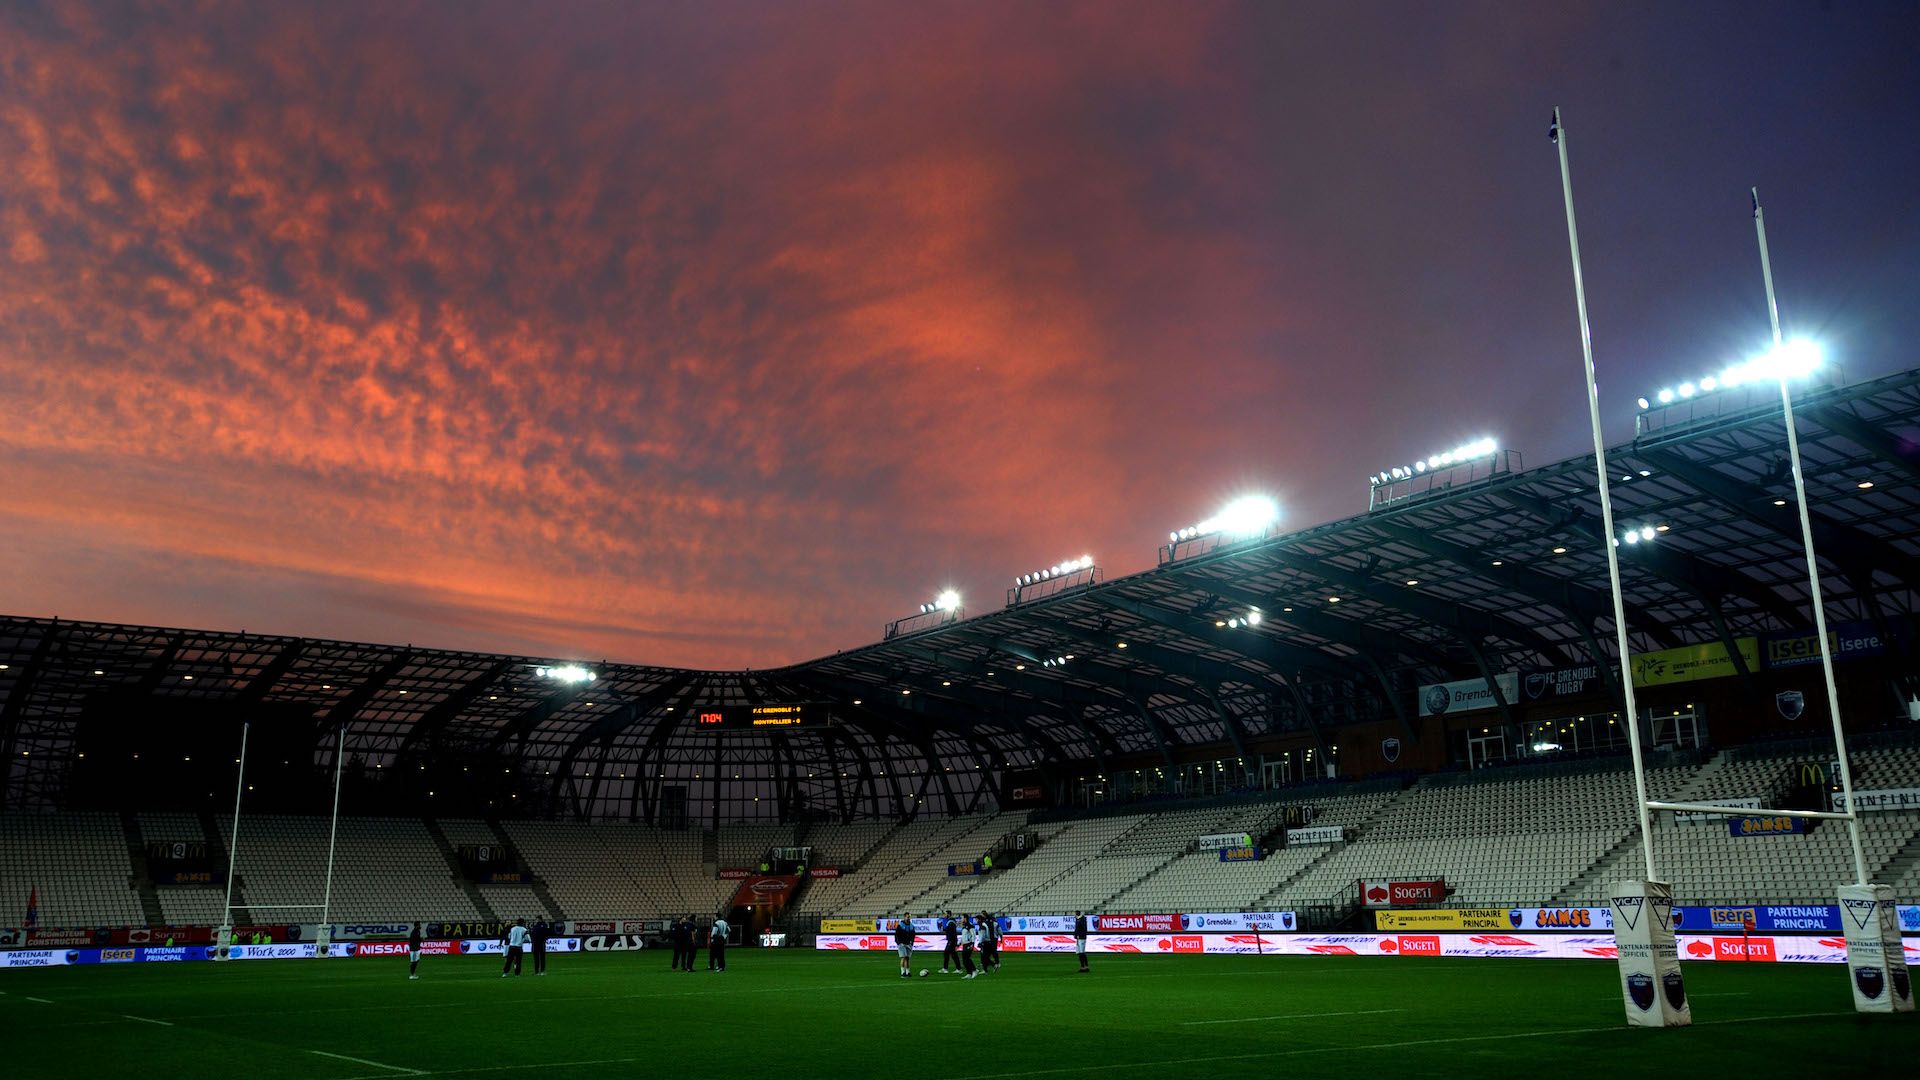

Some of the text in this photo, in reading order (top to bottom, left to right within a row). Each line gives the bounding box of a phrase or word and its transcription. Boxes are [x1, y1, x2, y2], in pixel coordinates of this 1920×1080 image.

[1546, 666, 1597, 685] FC GRENOBLE
[1556, 680, 1584, 695] RUGBY
[763, 706, 792, 714] GRENOBLE
[810, 869, 839, 877] NISSAN
[1394, 886, 1432, 899] SOGETI
[1614, 897, 1643, 906] VICAT
[1844, 900, 1876, 909] VICAT
[1243, 913, 1275, 921] PARTENAIRE
[1459, 910, 1502, 918] PARTENAIRE
[1767, 907, 1829, 918] PARTENAIRE
[1101, 917, 1143, 929] NISSAN
[1536, 909, 1591, 928] SAMSE
[1463, 919, 1500, 928] PRINCIPAL
[1773, 918, 1827, 929] PRINCIPAL
[344, 925, 409, 936] PORTALP
[27, 937, 91, 946] CONSTRUCTEUR
[584, 935, 645, 952] CLAS
[1175, 939, 1200, 949] SOGETI
[1402, 940, 1436, 951] SOGETI
[8, 951, 53, 959] PARTENAIRE
[144, 946, 186, 955] PARTENAIRE
[248, 946, 296, 958] Work 2000
[9, 958, 49, 966] PRINCIPAL
[146, 954, 182, 962] PRINCIPAL
